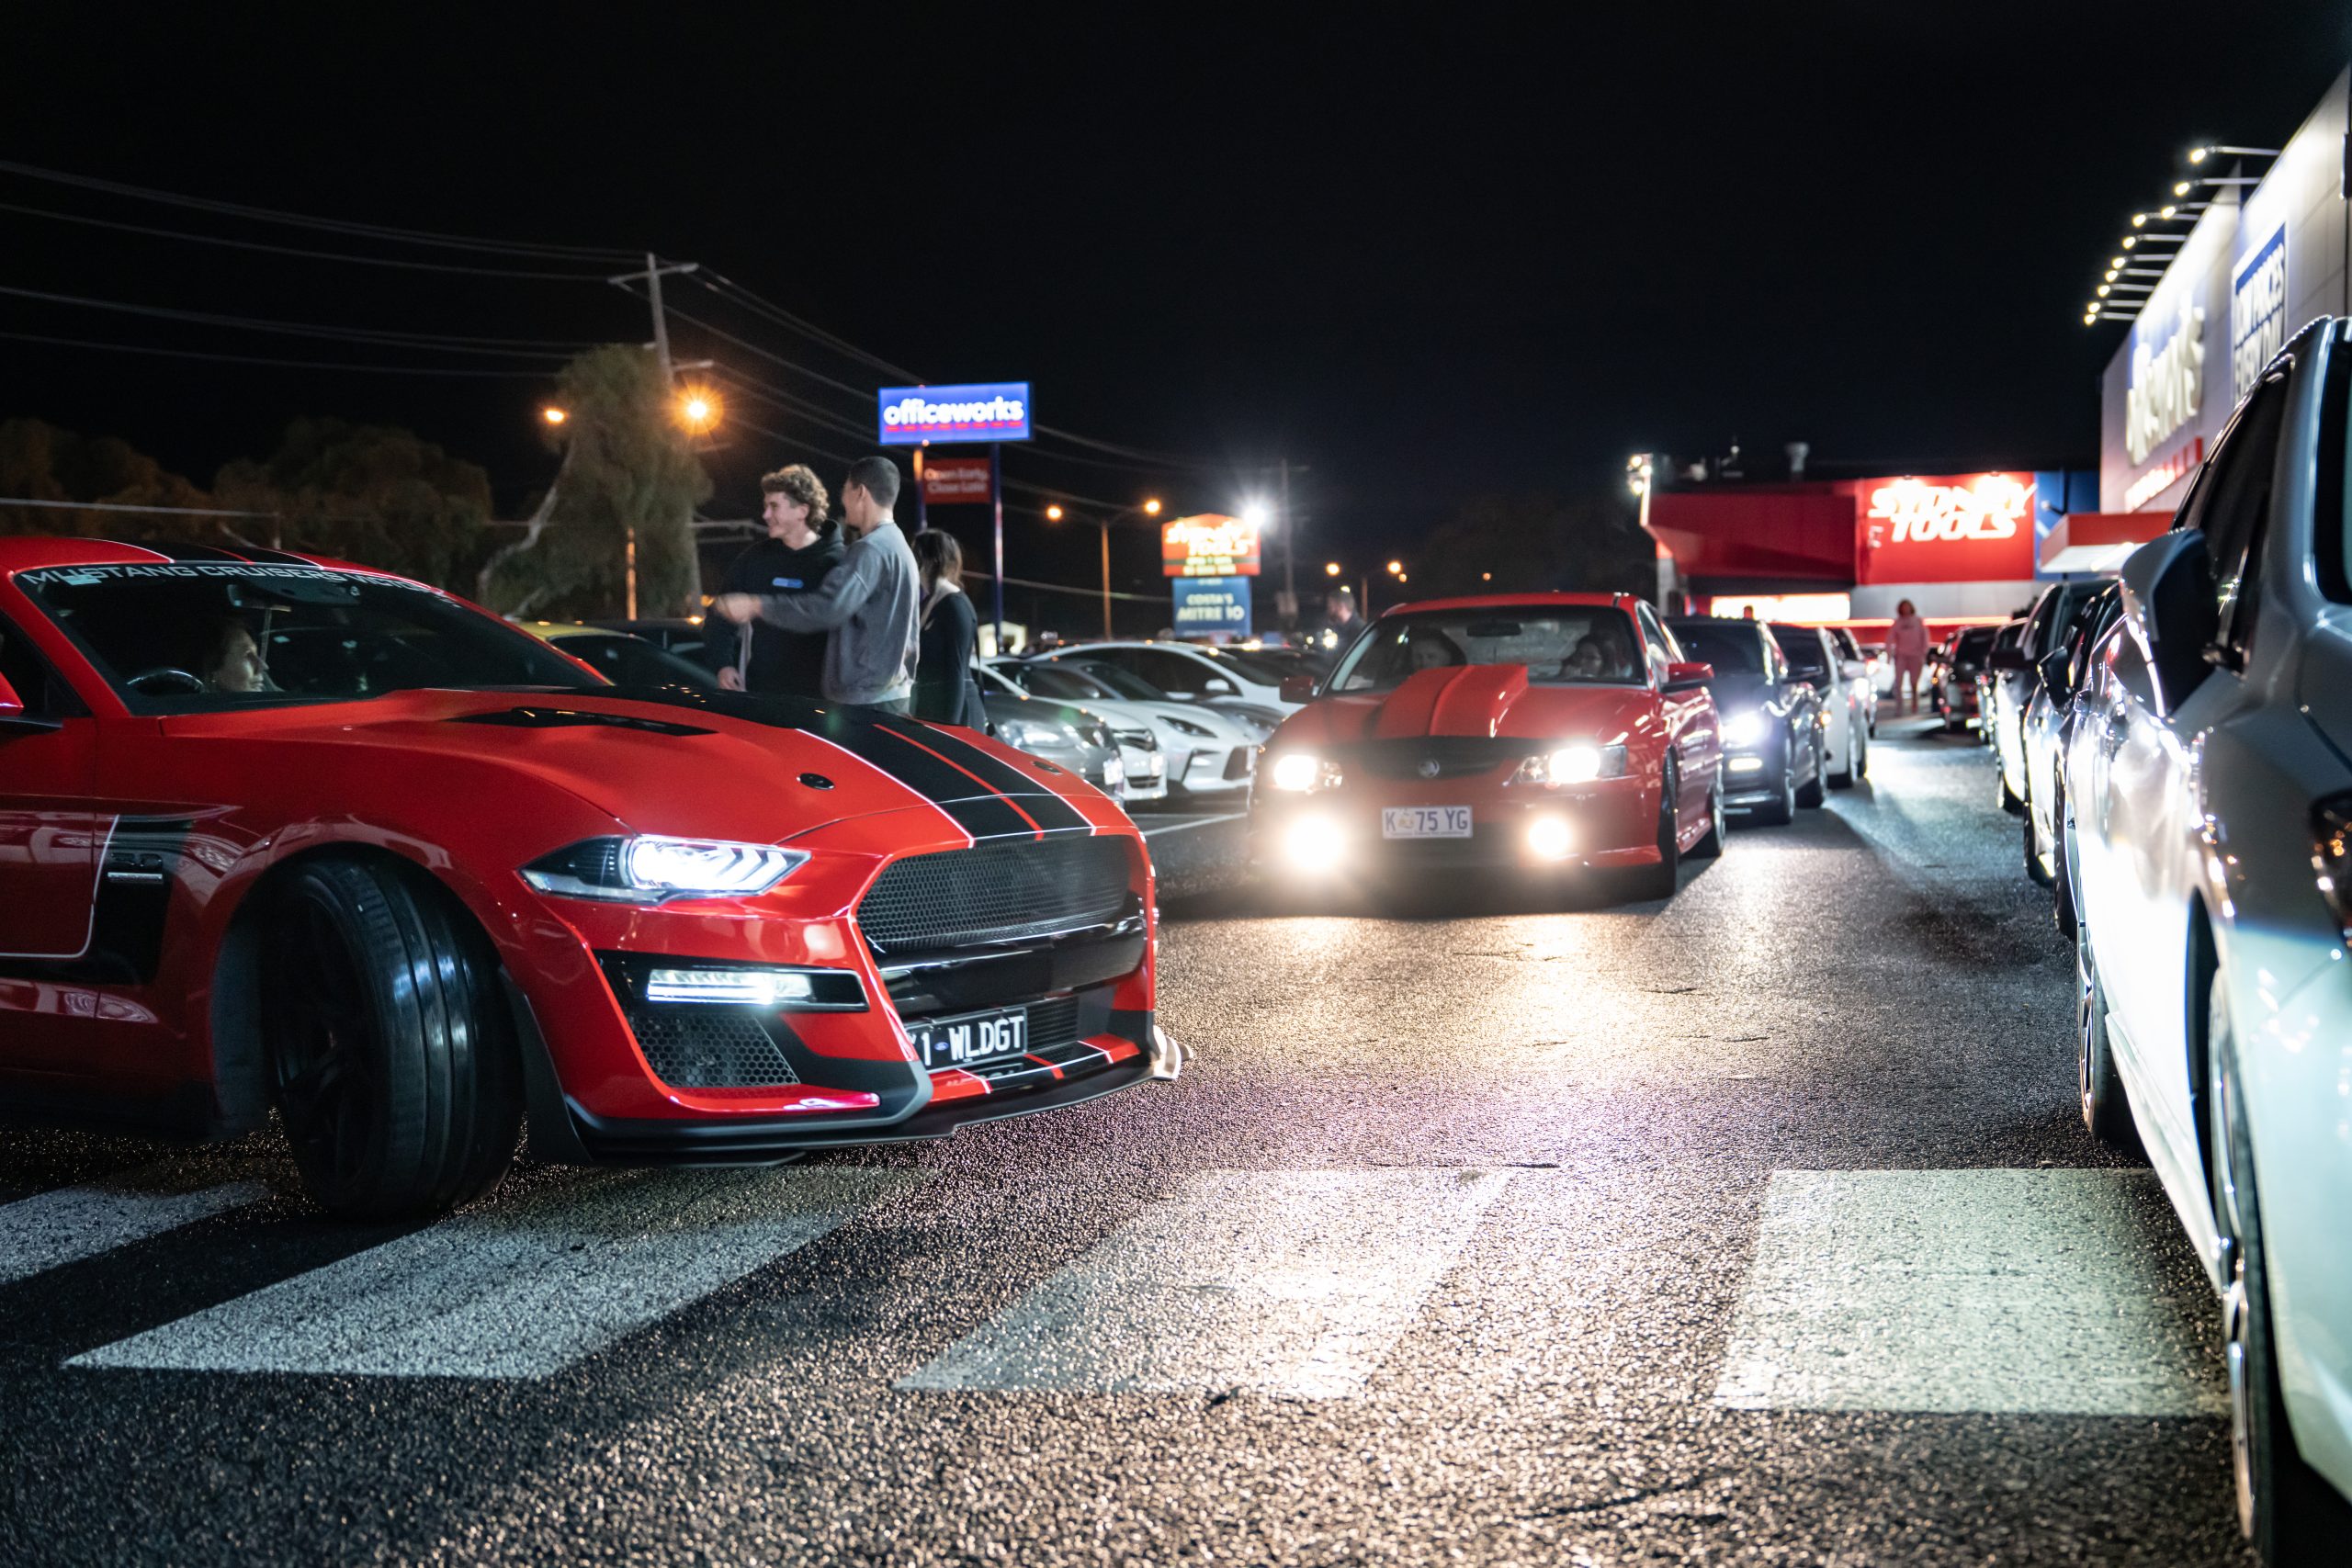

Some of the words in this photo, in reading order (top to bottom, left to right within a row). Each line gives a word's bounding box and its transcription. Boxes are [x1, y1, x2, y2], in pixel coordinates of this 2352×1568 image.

[883, 395, 1024, 425] officeworks
[1891, 511, 2024, 542] TOOLS
[21, 566, 198, 585] MUSTANG
[196, 566, 348, 582] CRUISERS
[1177, 606, 1224, 622] MITRE
[1385, 811, 1396, 831] K
[1415, 811, 1439, 831] 75
[1444, 809, 1468, 830] YG
[948, 1015, 1024, 1061] WLDGT
